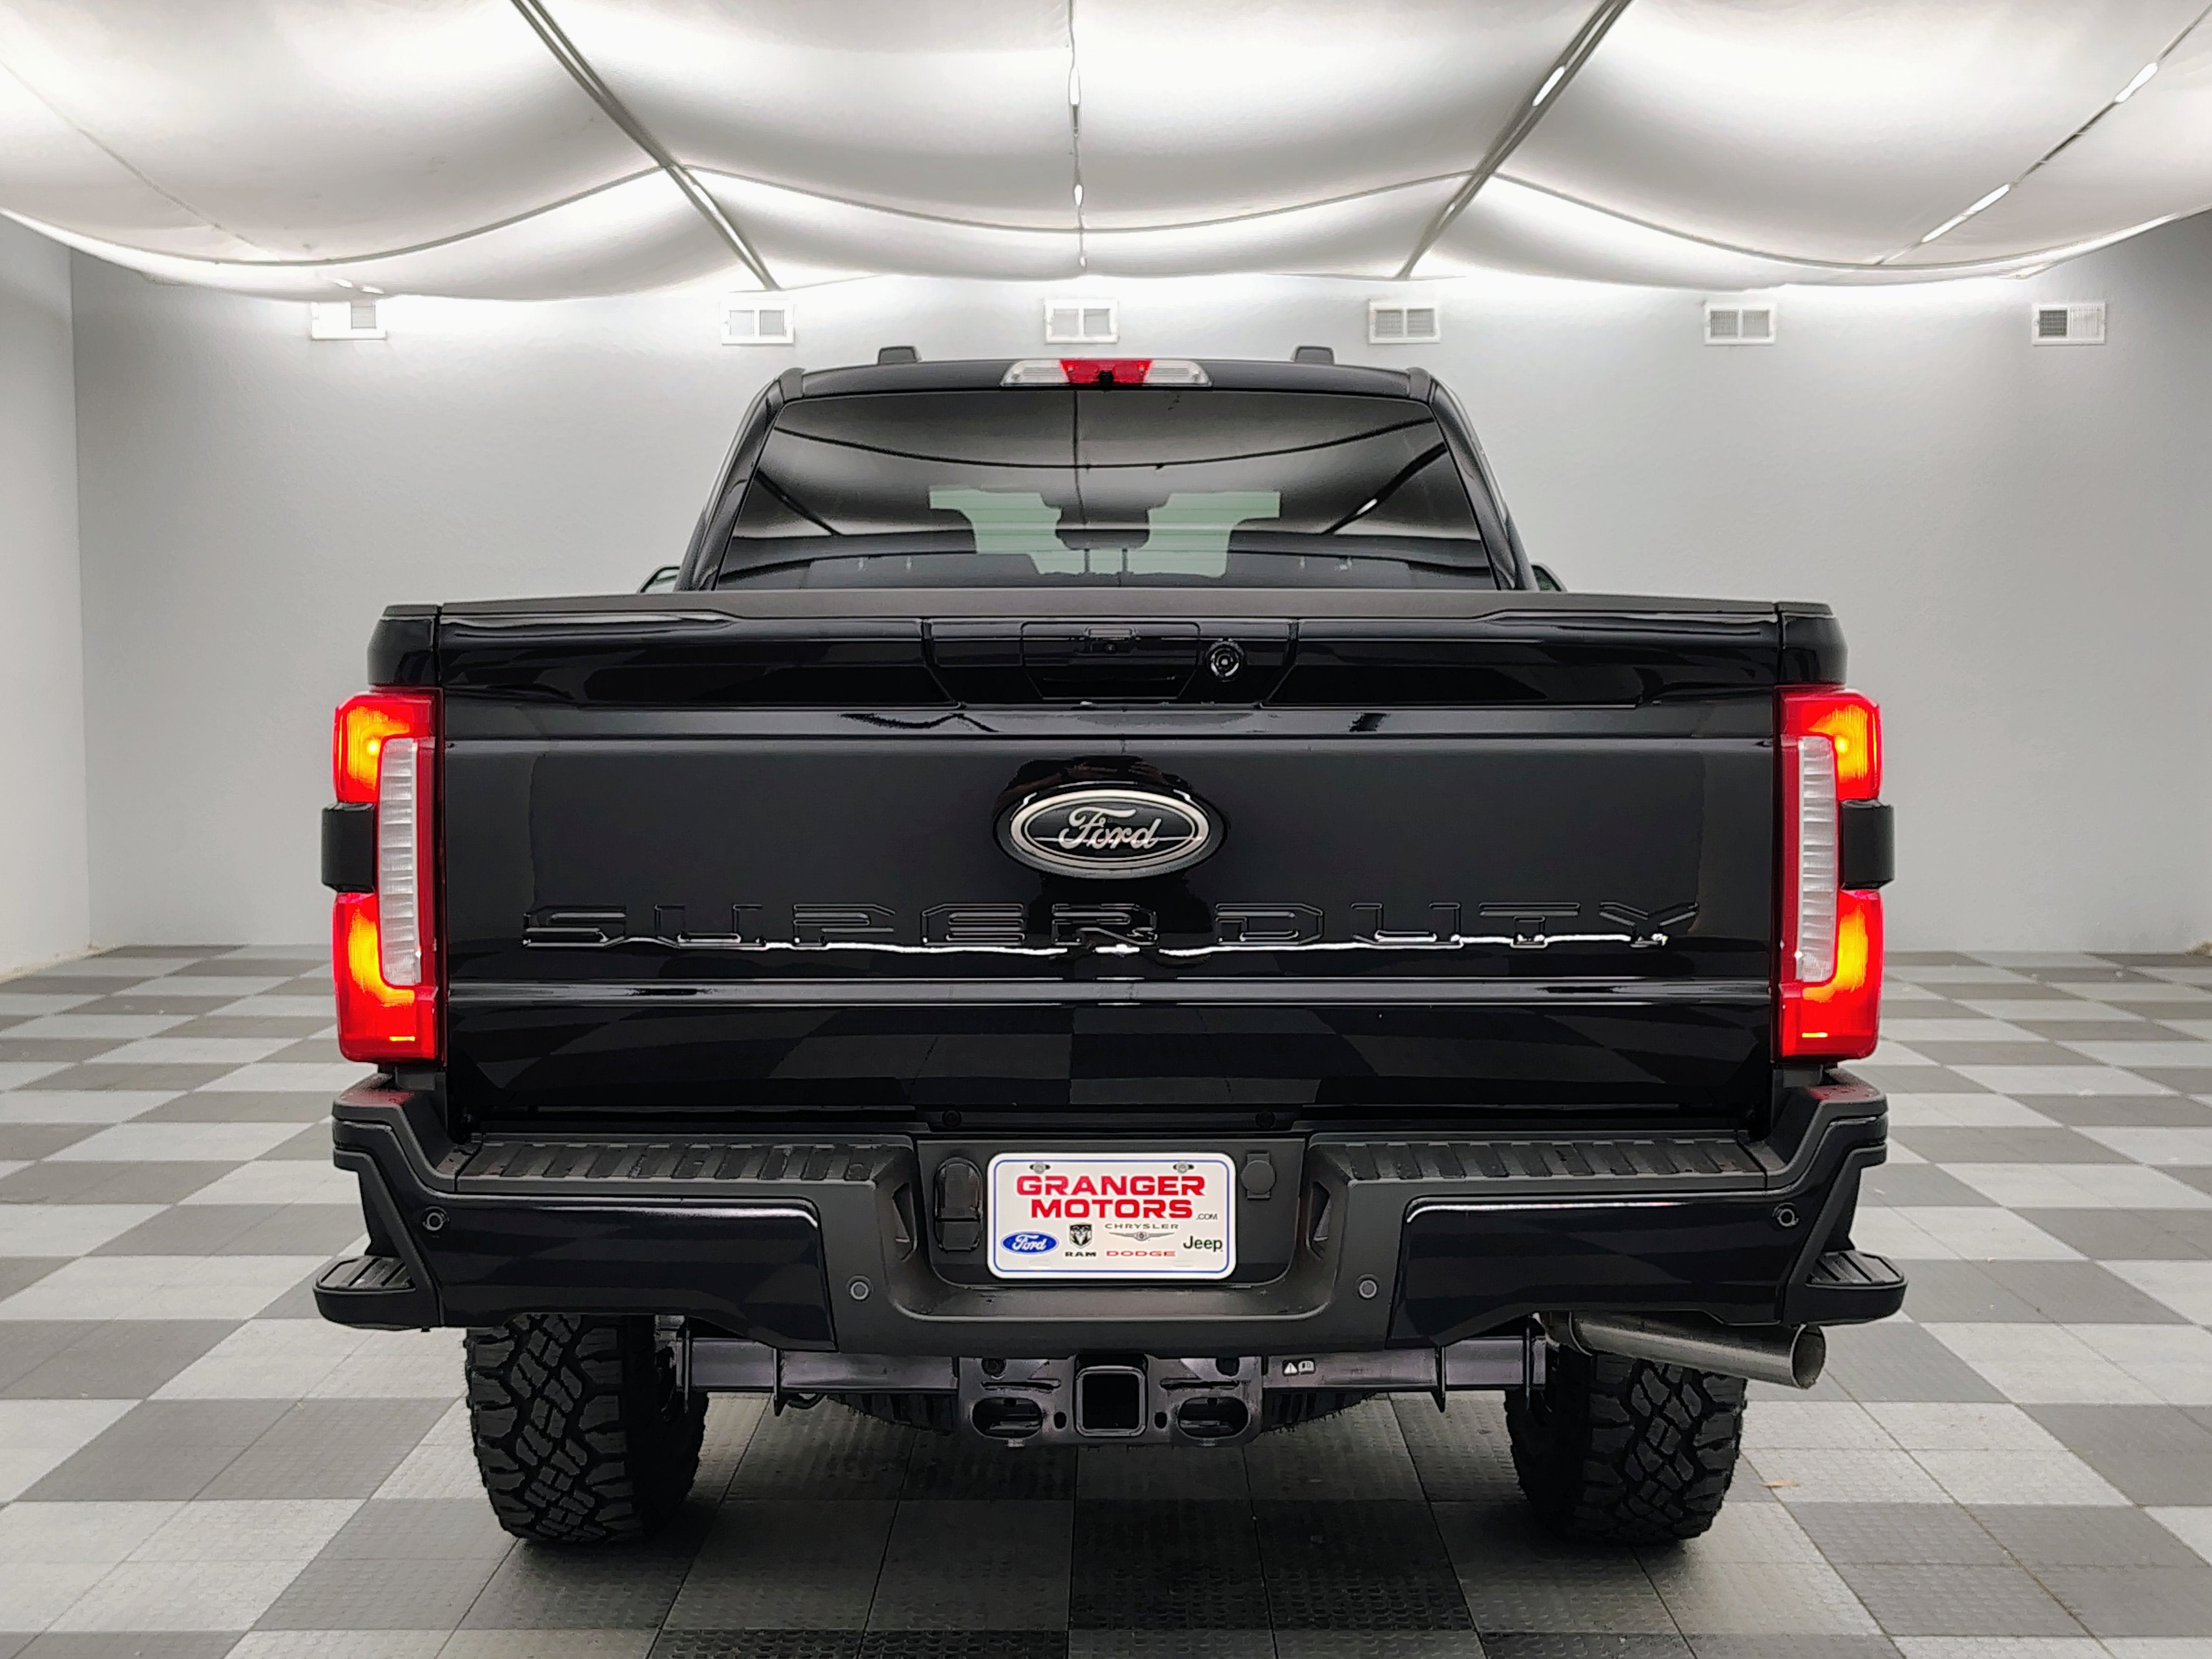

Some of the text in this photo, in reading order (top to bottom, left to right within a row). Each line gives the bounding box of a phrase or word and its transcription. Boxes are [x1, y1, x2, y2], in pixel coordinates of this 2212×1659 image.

[1058, 806, 1163, 849] Ford
[523, 901, 1700, 949] SUPER DUTY
[1016, 1175, 1206, 1196] GRANGER
[1031, 1199, 1192, 1219] MOTORS
[1011, 1233, 1047, 1251] Ford
[1183, 1235, 1223, 1252] Jeep
